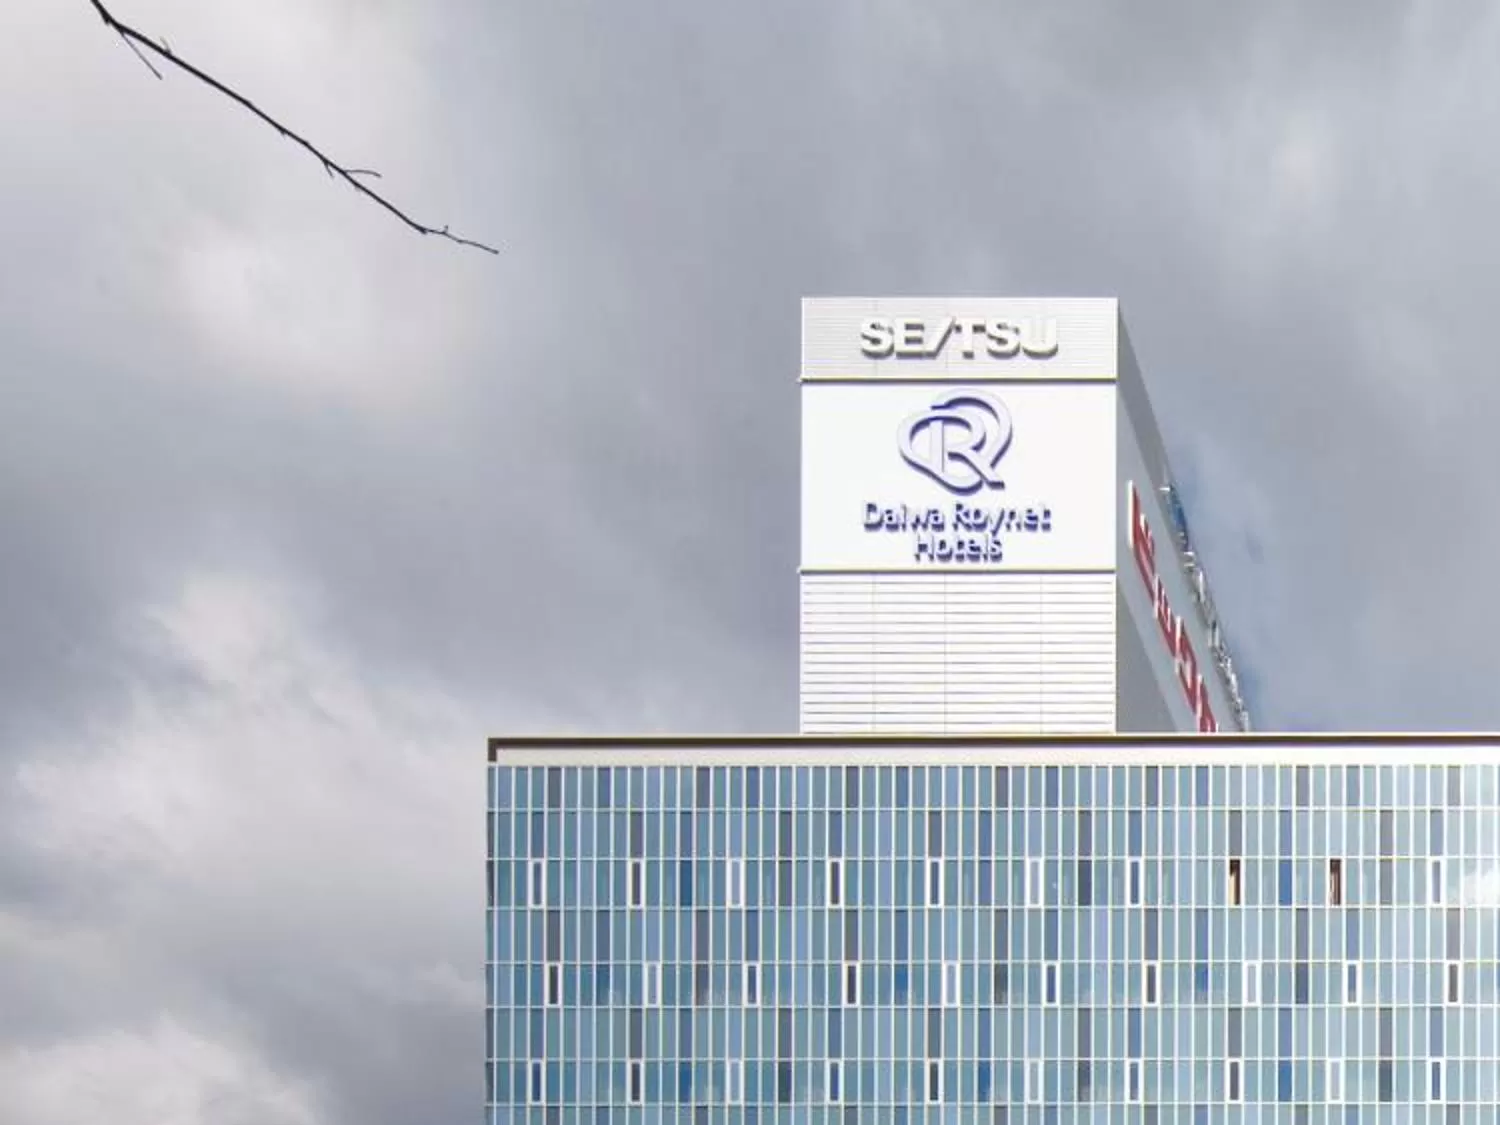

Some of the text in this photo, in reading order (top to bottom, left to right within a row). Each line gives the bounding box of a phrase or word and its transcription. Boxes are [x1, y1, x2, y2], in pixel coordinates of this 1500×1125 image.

[863, 500, 1052, 537] Daiwa Roynet
[914, 534, 1004, 562] Hotels
